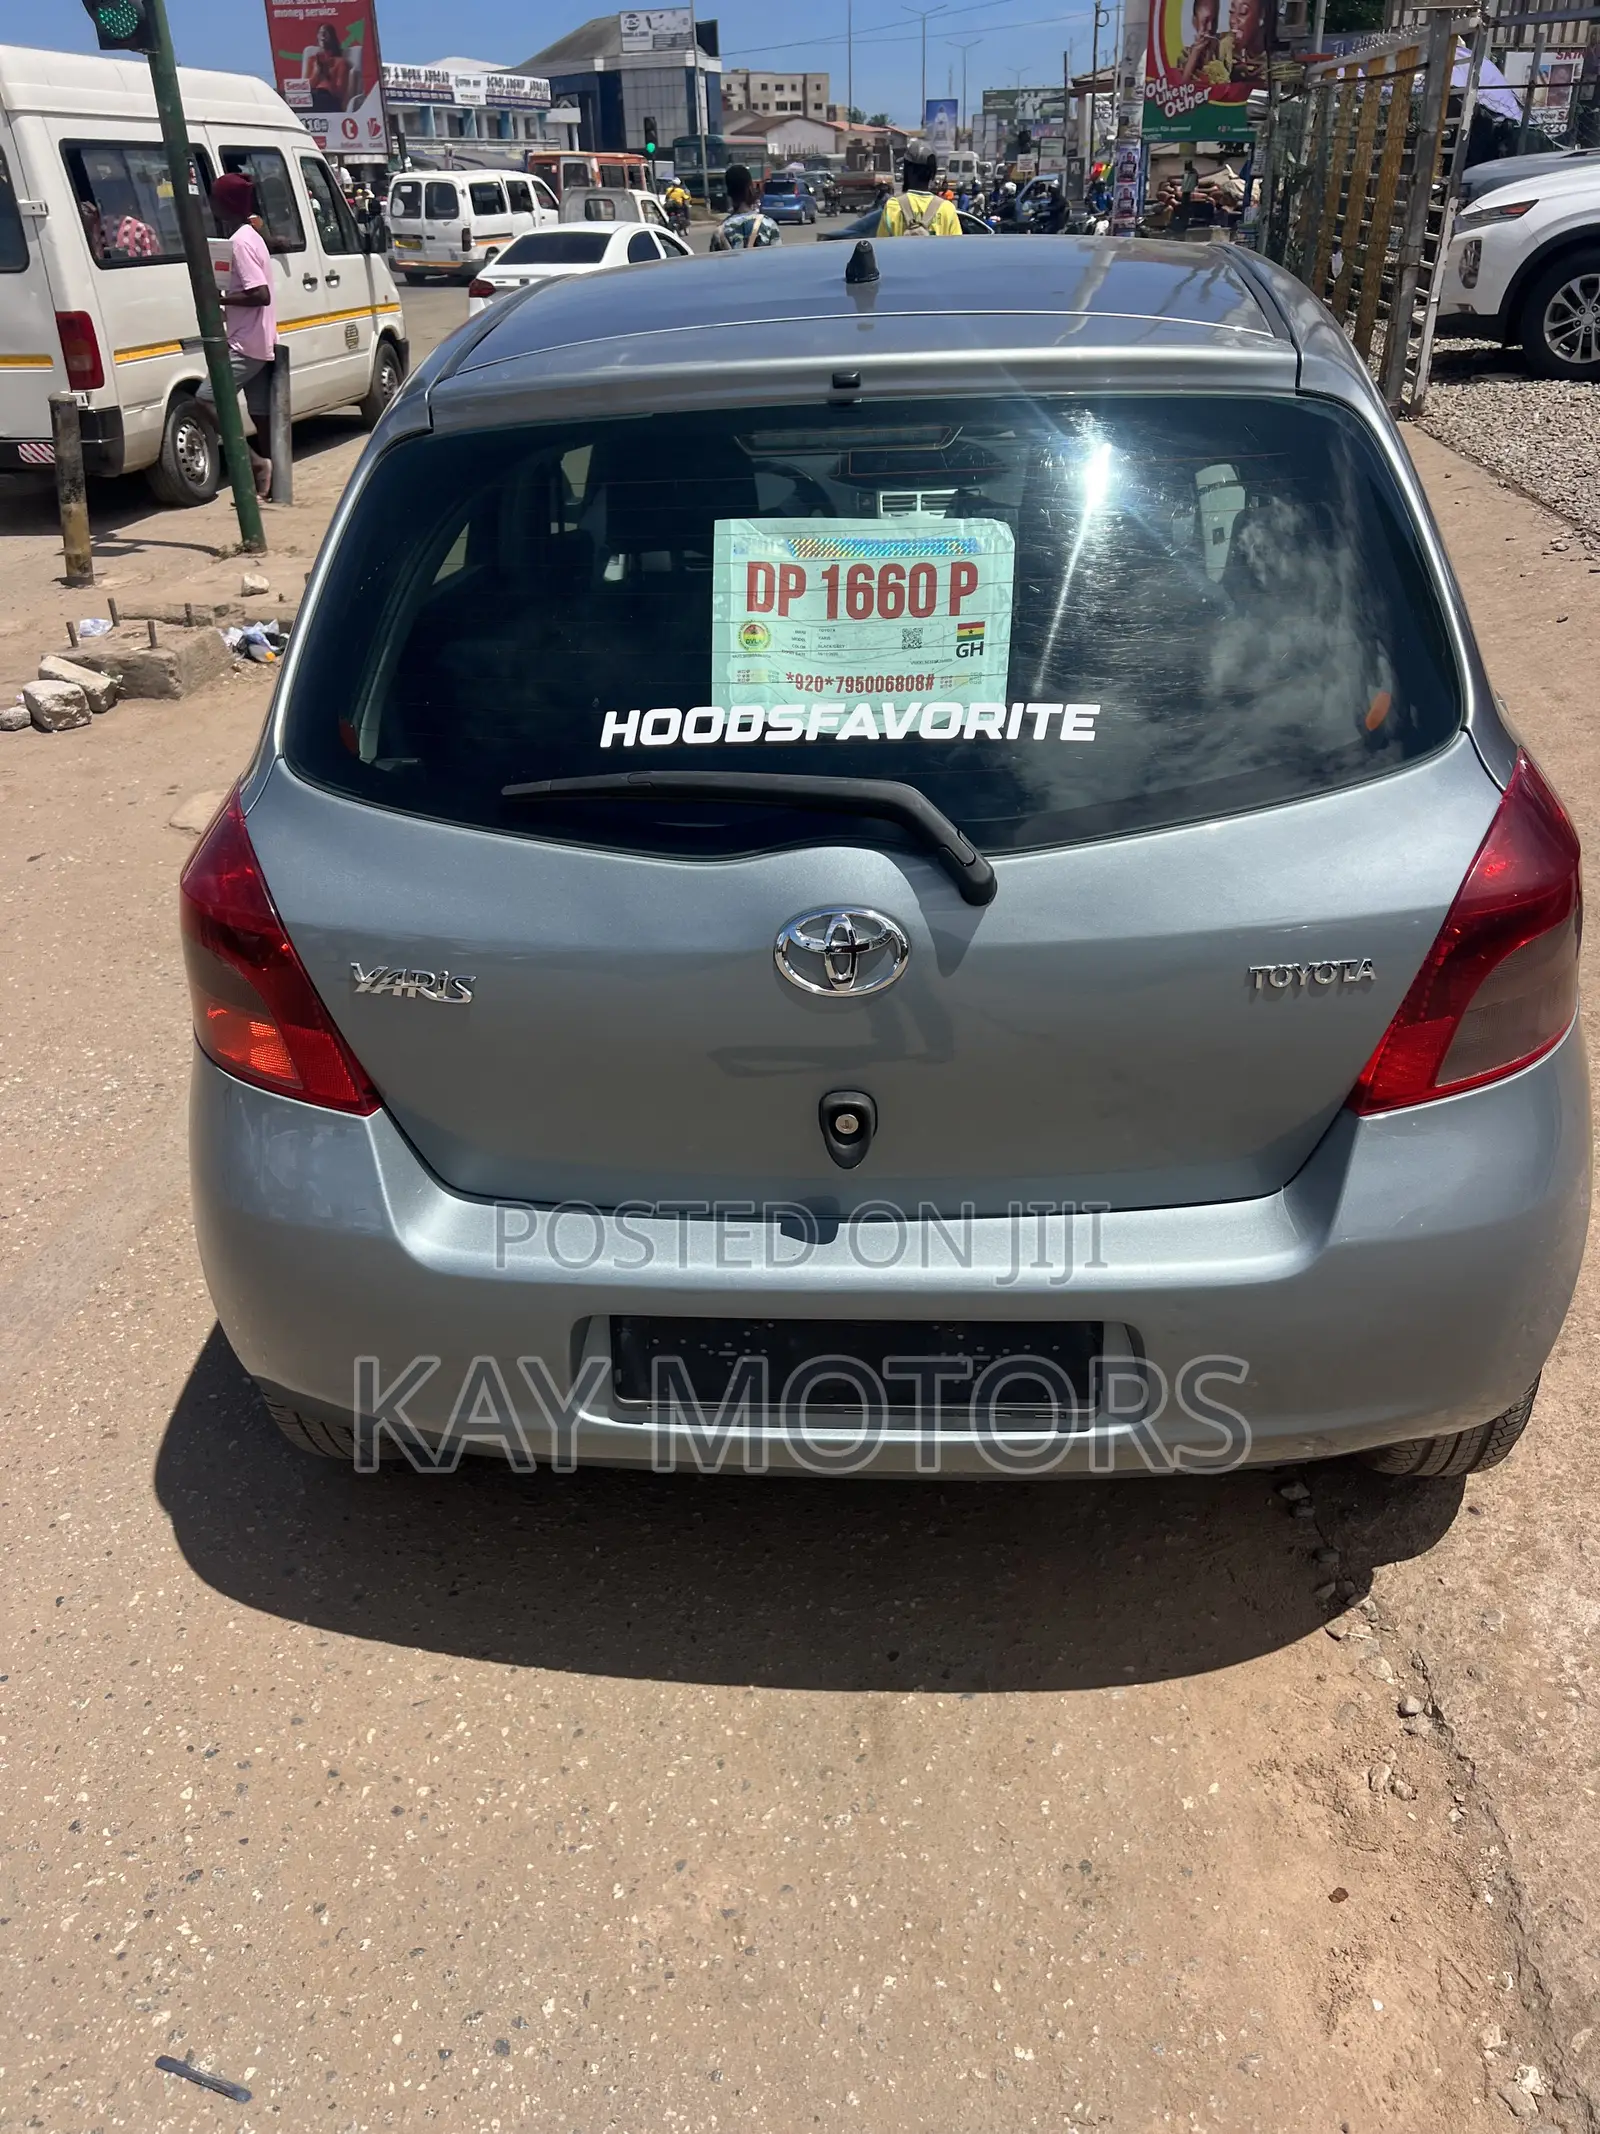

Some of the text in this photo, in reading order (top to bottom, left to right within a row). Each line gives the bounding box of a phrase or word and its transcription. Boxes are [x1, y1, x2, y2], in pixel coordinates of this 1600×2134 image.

[274, 9, 304, 20] money
[1164, 87, 1212, 117] Other
[746, 561, 979, 622] DP 1660 P
[955, 641, 985, 658] GH
[599, 702, 1101, 748] HOODSFAVORITE
[1248, 957, 1378, 990] TOYOTA
